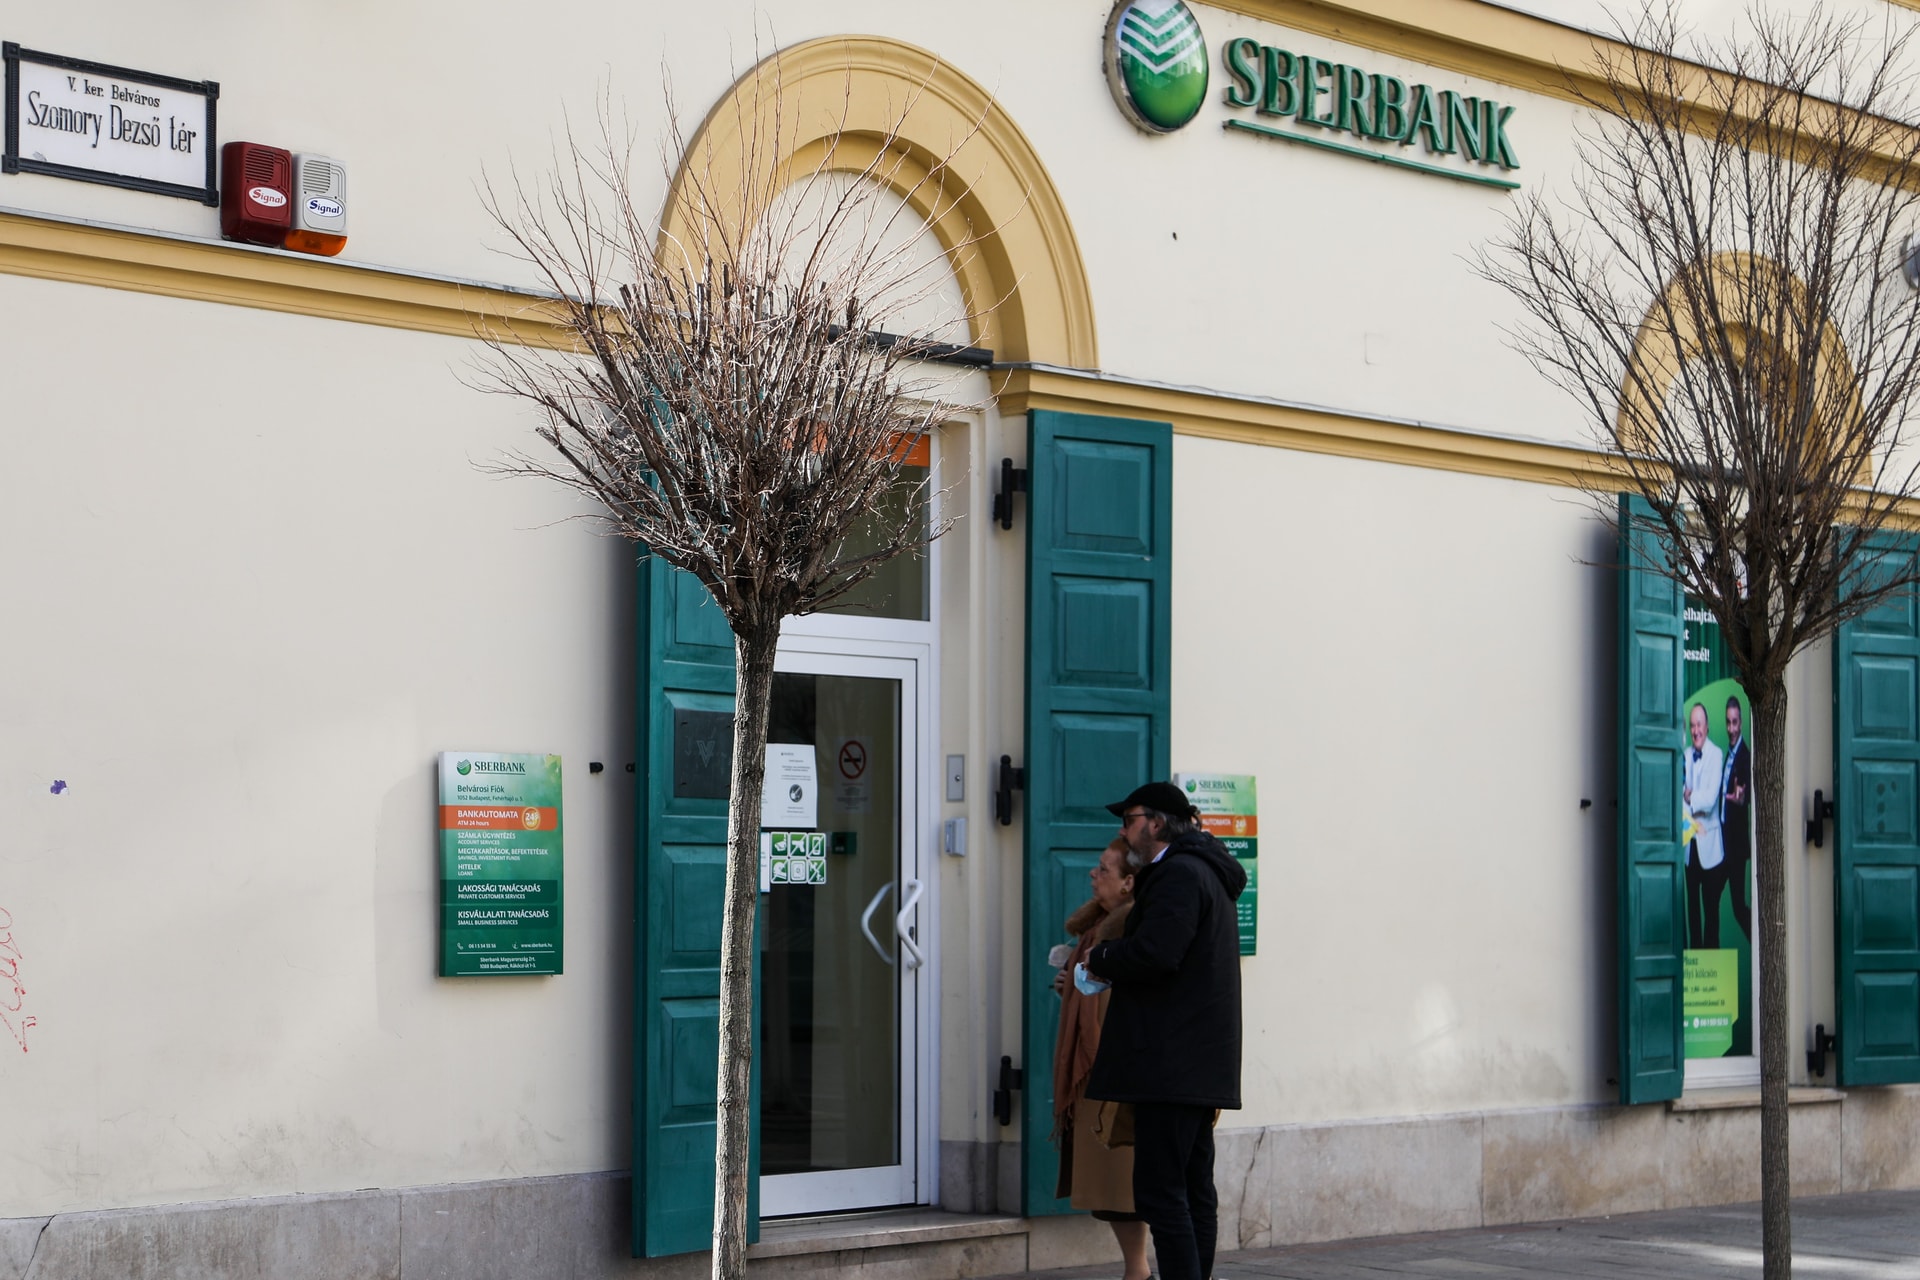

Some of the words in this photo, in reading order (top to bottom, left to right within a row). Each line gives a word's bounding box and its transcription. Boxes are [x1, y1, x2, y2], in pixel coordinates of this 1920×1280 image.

[67, 76, 77, 92] V.
[85, 79, 105, 97] ker.
[112, 85, 161, 108] Belváros
[1224, 37, 1521, 170] SBERBANK
[27, 91, 102, 148] Szomory
[110, 104, 161, 147] Dezső
[169, 116, 197, 153] tér
[252, 188, 284, 206] Signal
[309, 199, 341, 215] Signal
[474, 761, 526, 773] SBERBANK
[457, 784, 489, 793] Belvárosi
[490, 785, 505, 793] Fiók
[1199, 780, 1237, 790] SBERBANK
[457, 810, 519, 819] BANKAUTOMATA
[457, 831, 482, 839] SZÁMLA
[457, 884, 497, 893] LAKOSSÁGI
[498, 884, 541, 893] TANÁCSADÁS
[457, 909, 506, 918] KISVÁLLALATI
[507, 910, 550, 918] TANÁCSADÁS
